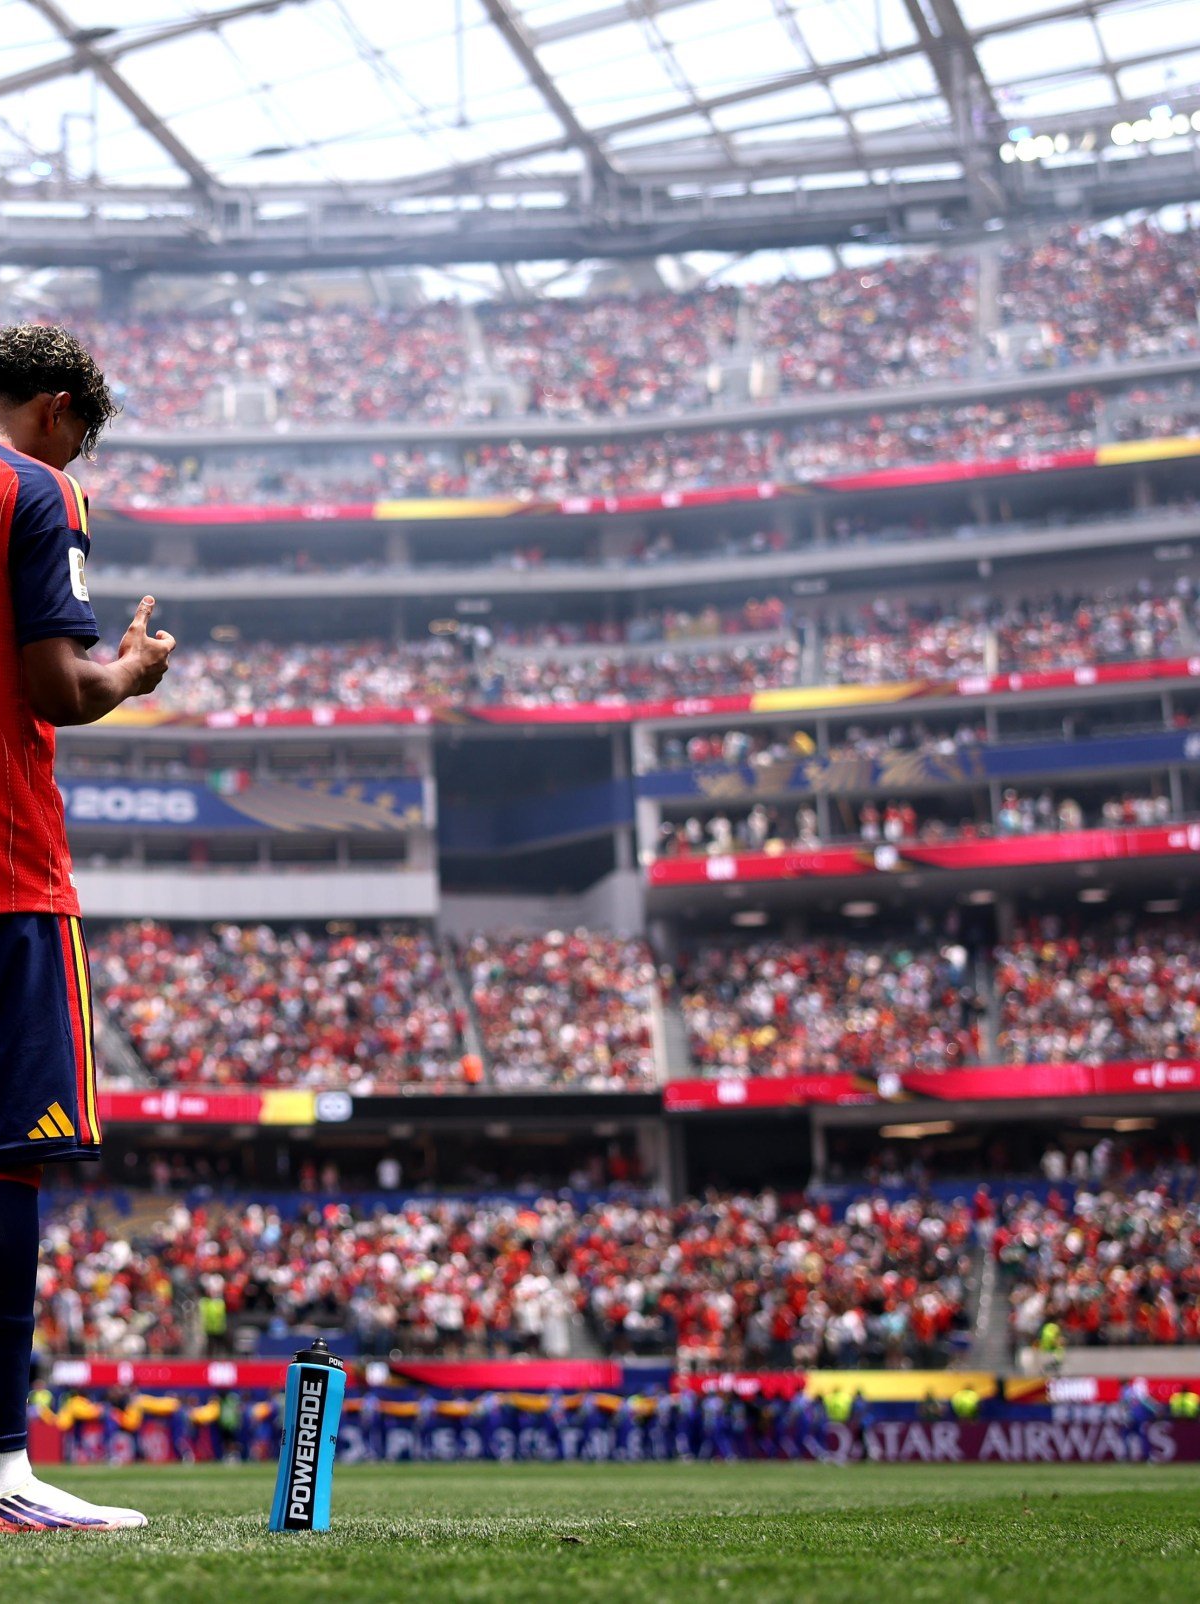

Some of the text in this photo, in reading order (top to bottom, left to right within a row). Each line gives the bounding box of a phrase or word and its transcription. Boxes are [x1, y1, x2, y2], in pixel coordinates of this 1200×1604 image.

[72, 786, 197, 822] 2026
[289, 1380, 323, 1521] POWERADE
[818, 1420, 966, 1466] QATAR
